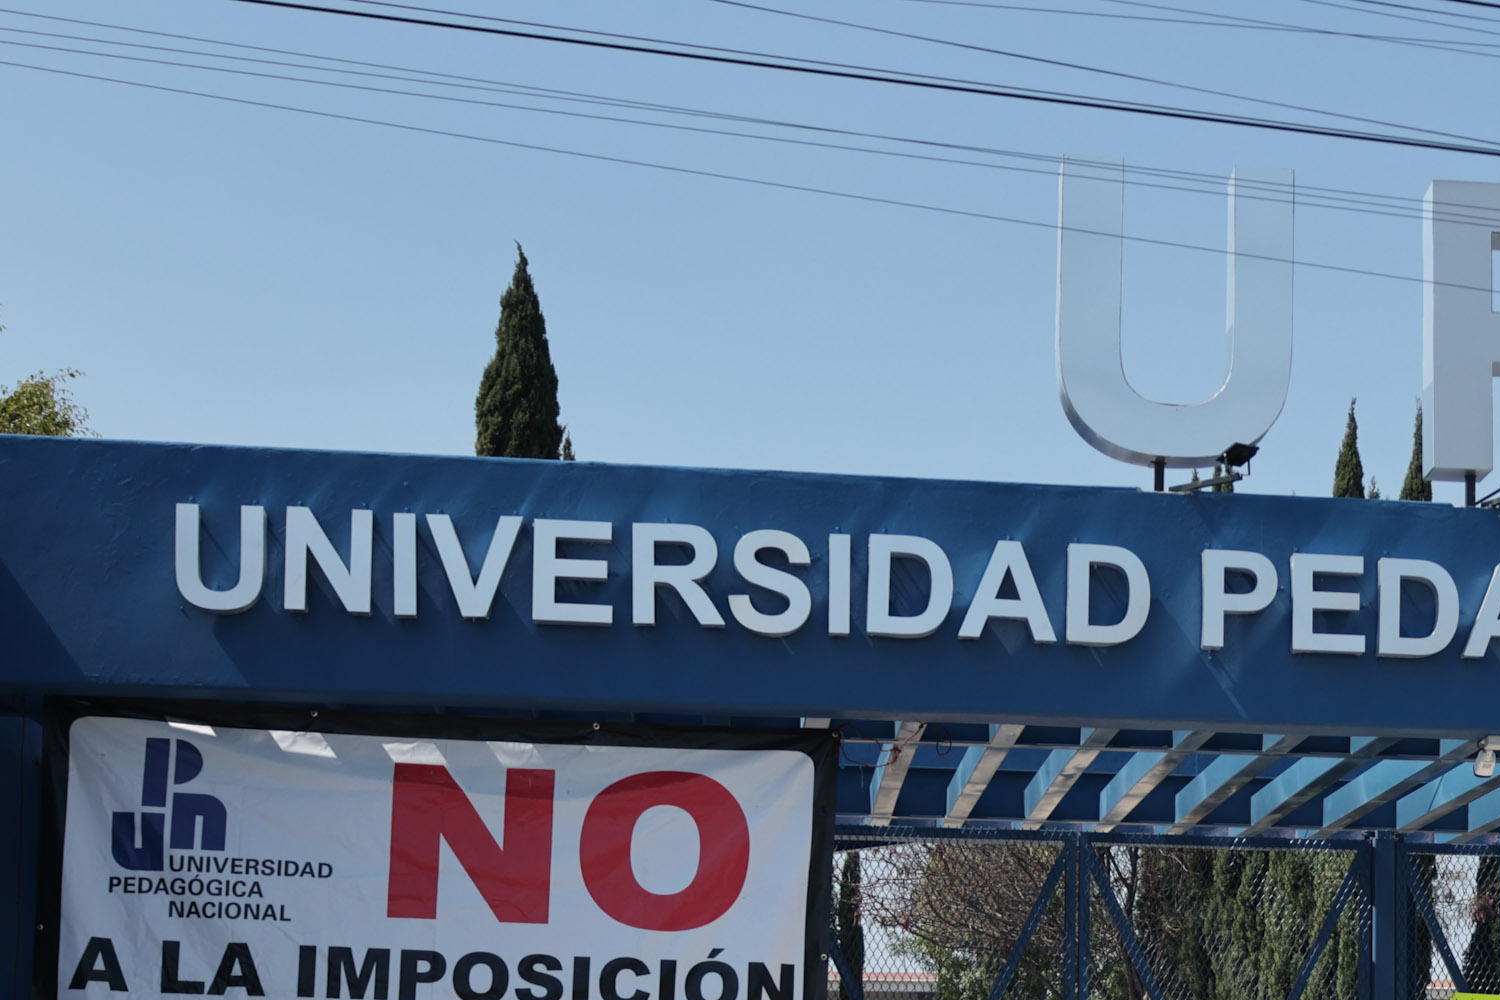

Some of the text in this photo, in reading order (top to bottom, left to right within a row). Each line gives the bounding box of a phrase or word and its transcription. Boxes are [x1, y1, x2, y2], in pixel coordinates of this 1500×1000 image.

[174, 502, 1151, 647] UNIVERSIDAD
[168, 855, 334, 879] UNIVERSIDAD
[386, 762, 751, 932] NO
[108, 875, 264, 898] PEDAGÓGICA
[168, 901, 292, 922] NACIONAL
[69, 937, 128, 992] A
[160, 940, 265, 996] LA
